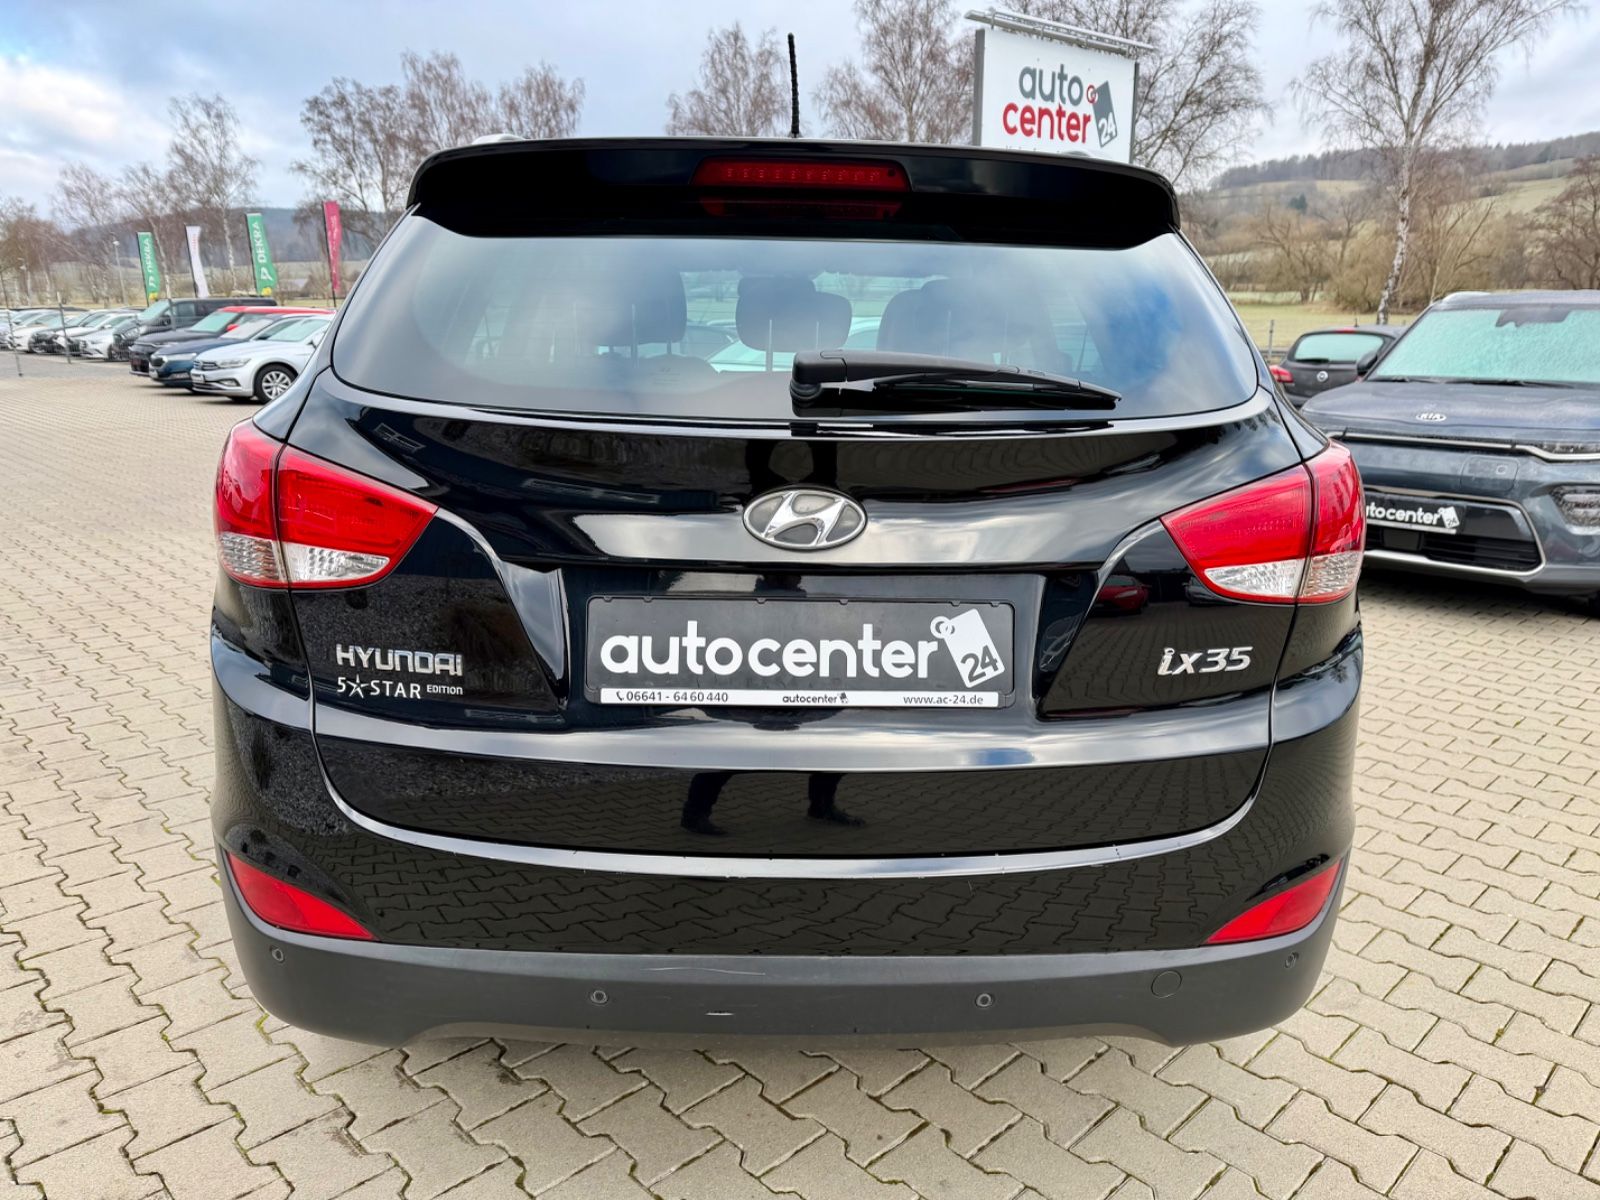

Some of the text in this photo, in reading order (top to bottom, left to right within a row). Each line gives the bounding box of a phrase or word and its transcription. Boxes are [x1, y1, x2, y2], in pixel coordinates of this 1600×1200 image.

[1019, 63, 1084, 106] auto
[1003, 102, 1117, 144] center 24
[251, 221, 267, 264] DEKRA
[1366, 501, 1440, 525] tocenter
[336, 643, 464, 677] HYUNDAI
[600, 619, 1000, 683] autocenter 24
[1157, 646, 1254, 676] ix35
[426, 684, 464, 696] EDITION
[626, 691, 662, 702] 06641
[782, 692, 838, 704] autocenter
[903, 694, 984, 706] www.ac-24.de
